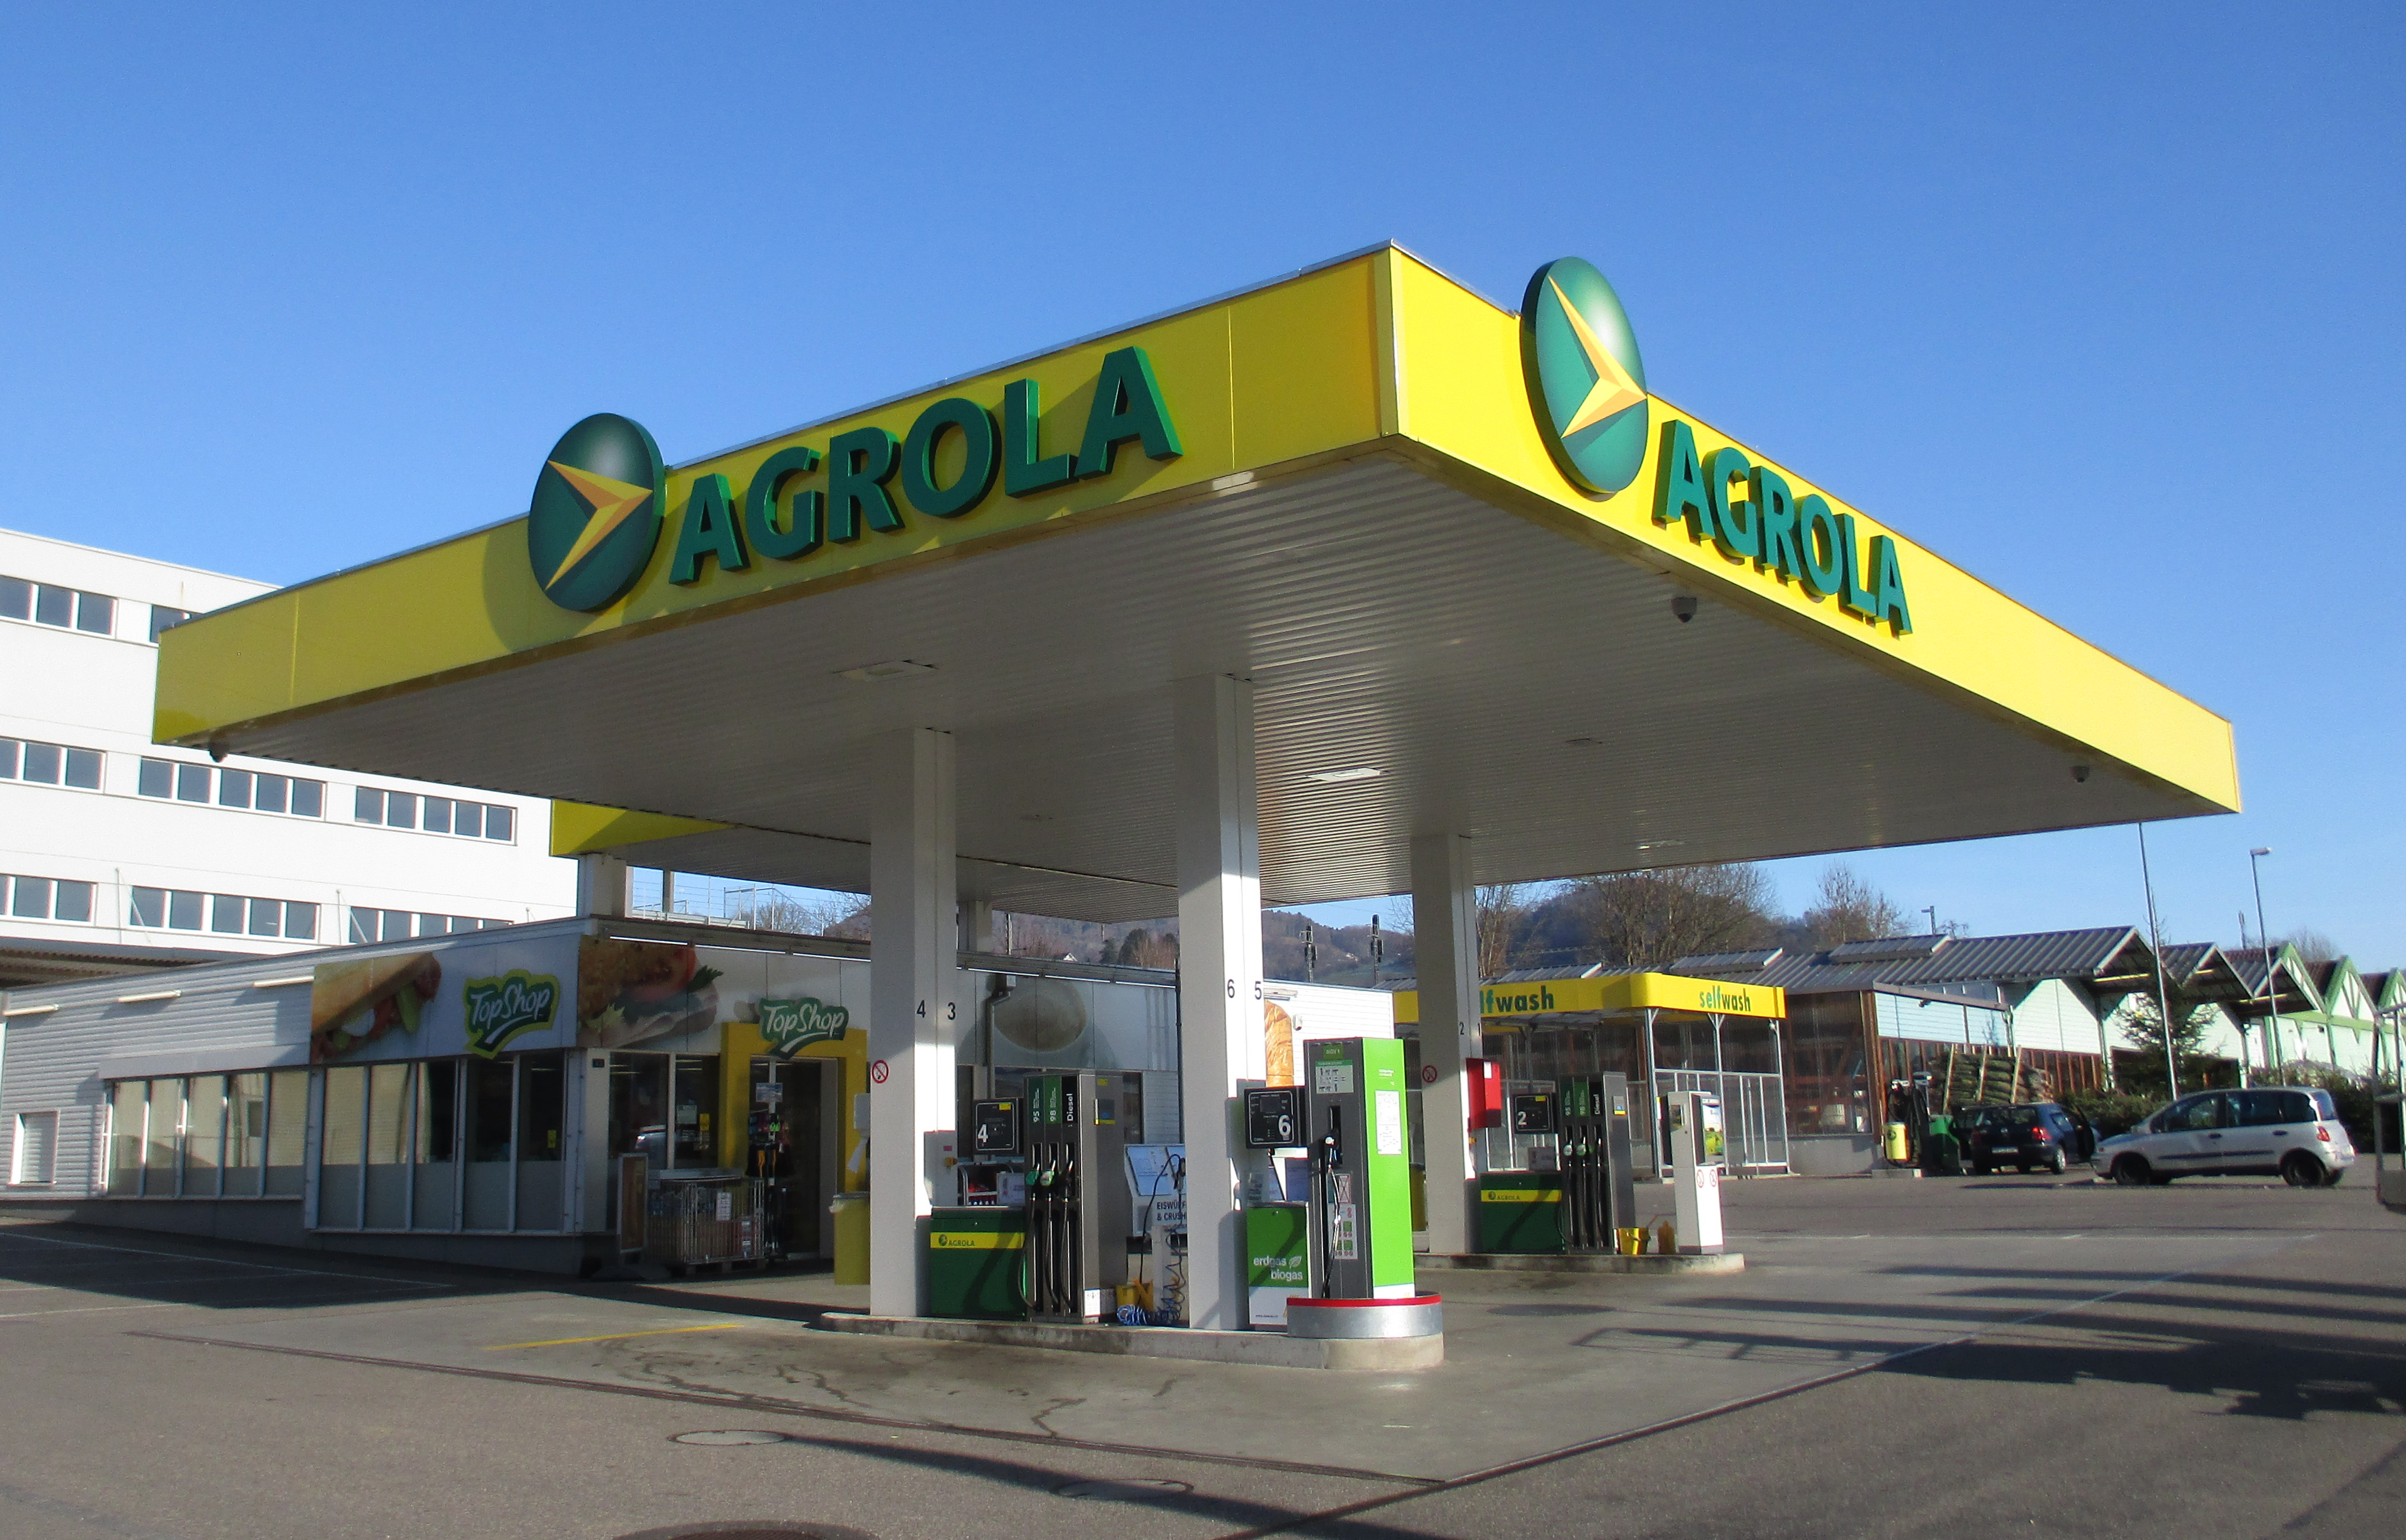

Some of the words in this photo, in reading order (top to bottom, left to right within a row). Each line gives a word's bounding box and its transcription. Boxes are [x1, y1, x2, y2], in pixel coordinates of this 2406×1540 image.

[668, 345, 1183, 587] AGROLA
[1652, 419, 1913, 640] AGROLA
[1227, 979, 1235, 998] 6
[1255, 981, 1262, 1000] 5
[1480, 985, 1554, 1014] lfwash
[1699, 985, 1751, 1012] selfwash
[917, 999, 926, 1018] 4
[947, 1002, 956, 1020] 3
[1459, 1021, 1464, 1035] 2
[1033, 1111, 1040, 1122] 95
[1050, 1109, 1056, 1122] 98
[1518, 1111, 1527, 1125] 2
[978, 1124, 988, 1143] 4
[1279, 1115, 1291, 1136] 6
[1253, 1256, 1287, 1269] erdgas
[1271, 1269, 1303, 1282] biogas
